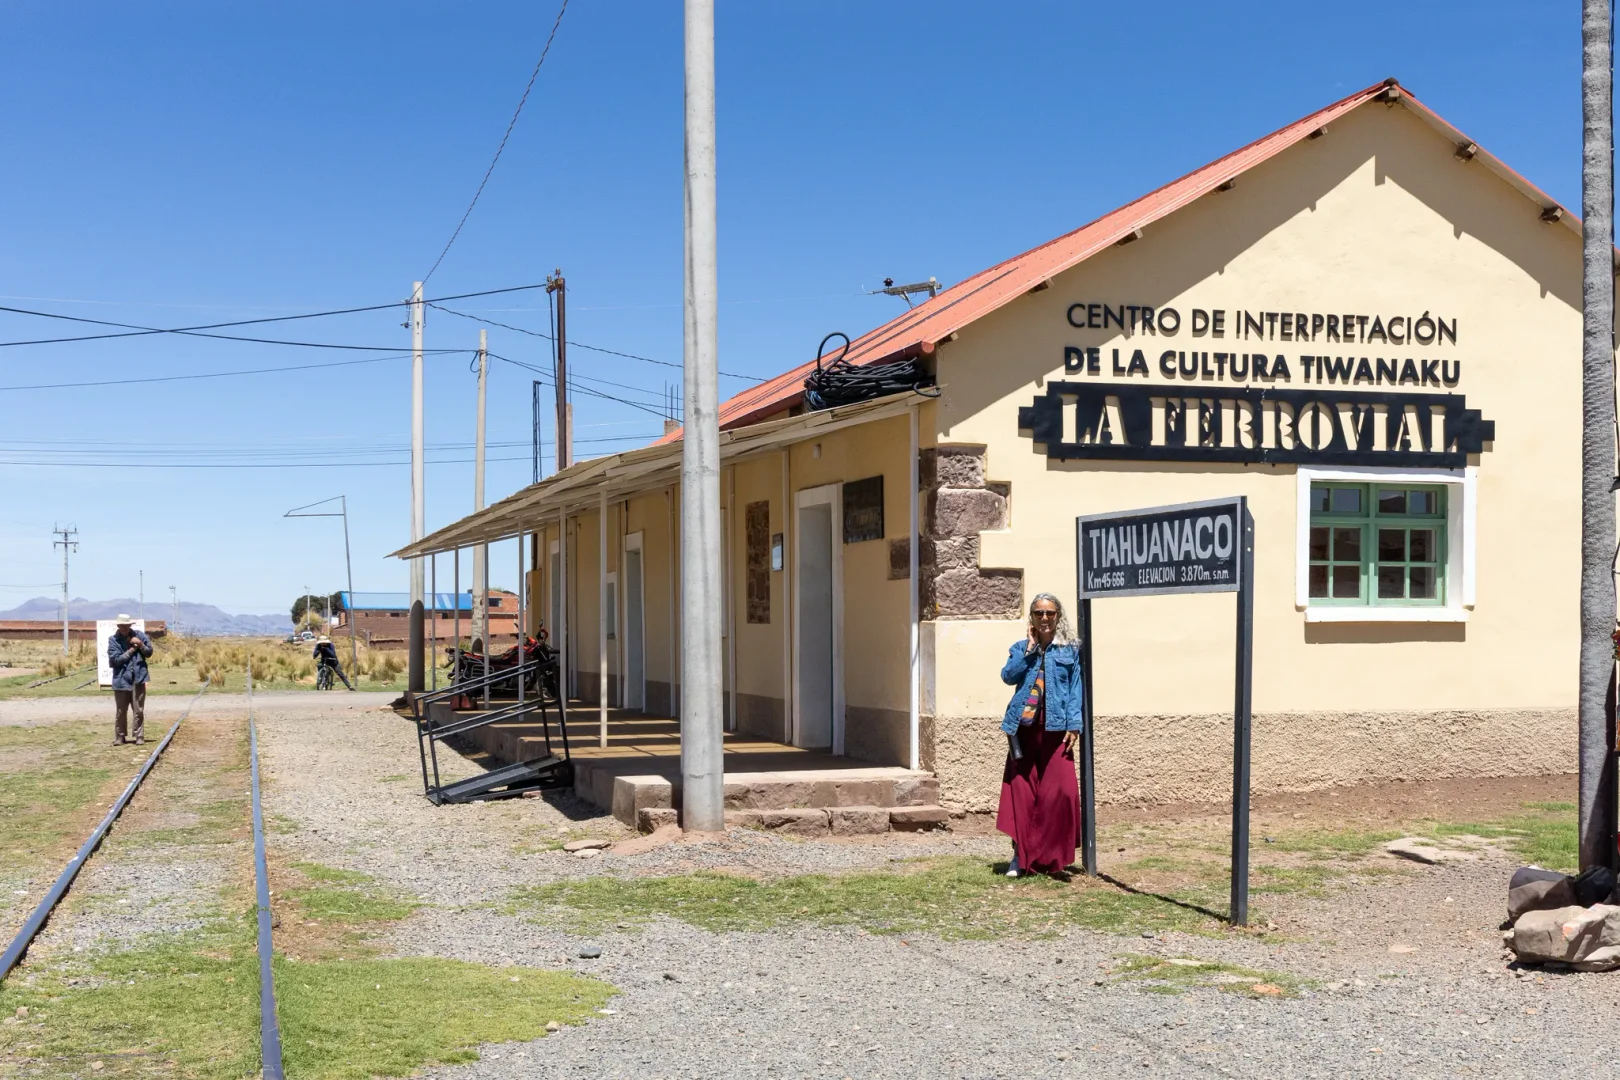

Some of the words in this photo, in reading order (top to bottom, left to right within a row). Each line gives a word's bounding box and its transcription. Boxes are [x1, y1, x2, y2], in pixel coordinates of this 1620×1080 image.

[1067, 303, 1180, 332] CENTRO
[1192, 309, 1225, 333] DE
[1237, 310, 1457, 342] INTERPRETACIÓN
[1064, 346, 1100, 371] DE
[1112, 348, 1149, 374] LA
[1159, 350, 1290, 380] CULTURA
[1300, 355, 1459, 383] TIWANAKU
[1060, 394, 1128, 444] LA
[1150, 396, 1458, 453] FERROVIAL
[1090, 514, 1232, 568] TIAHUANACO
[1138, 565, 1176, 585] ELEVACION
